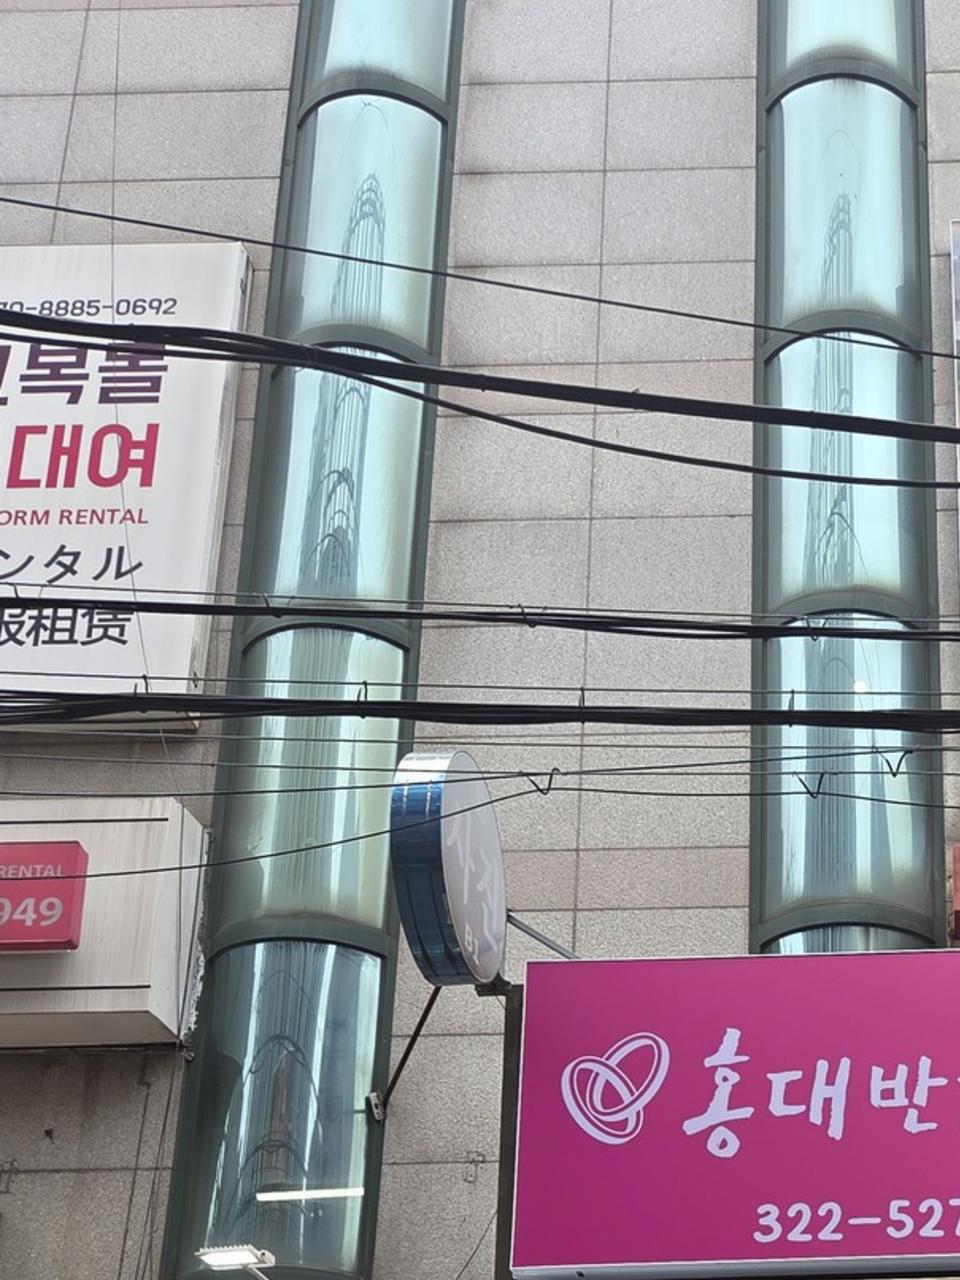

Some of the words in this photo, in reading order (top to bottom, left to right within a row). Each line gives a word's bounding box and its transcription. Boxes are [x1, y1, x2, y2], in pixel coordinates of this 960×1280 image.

[6, 423, 160, 490] 대여
[58, 508, 149, 525] RENTAL
[0, 543, 144, 584] ンタル
[0, 864, 64, 878] RENTAL
